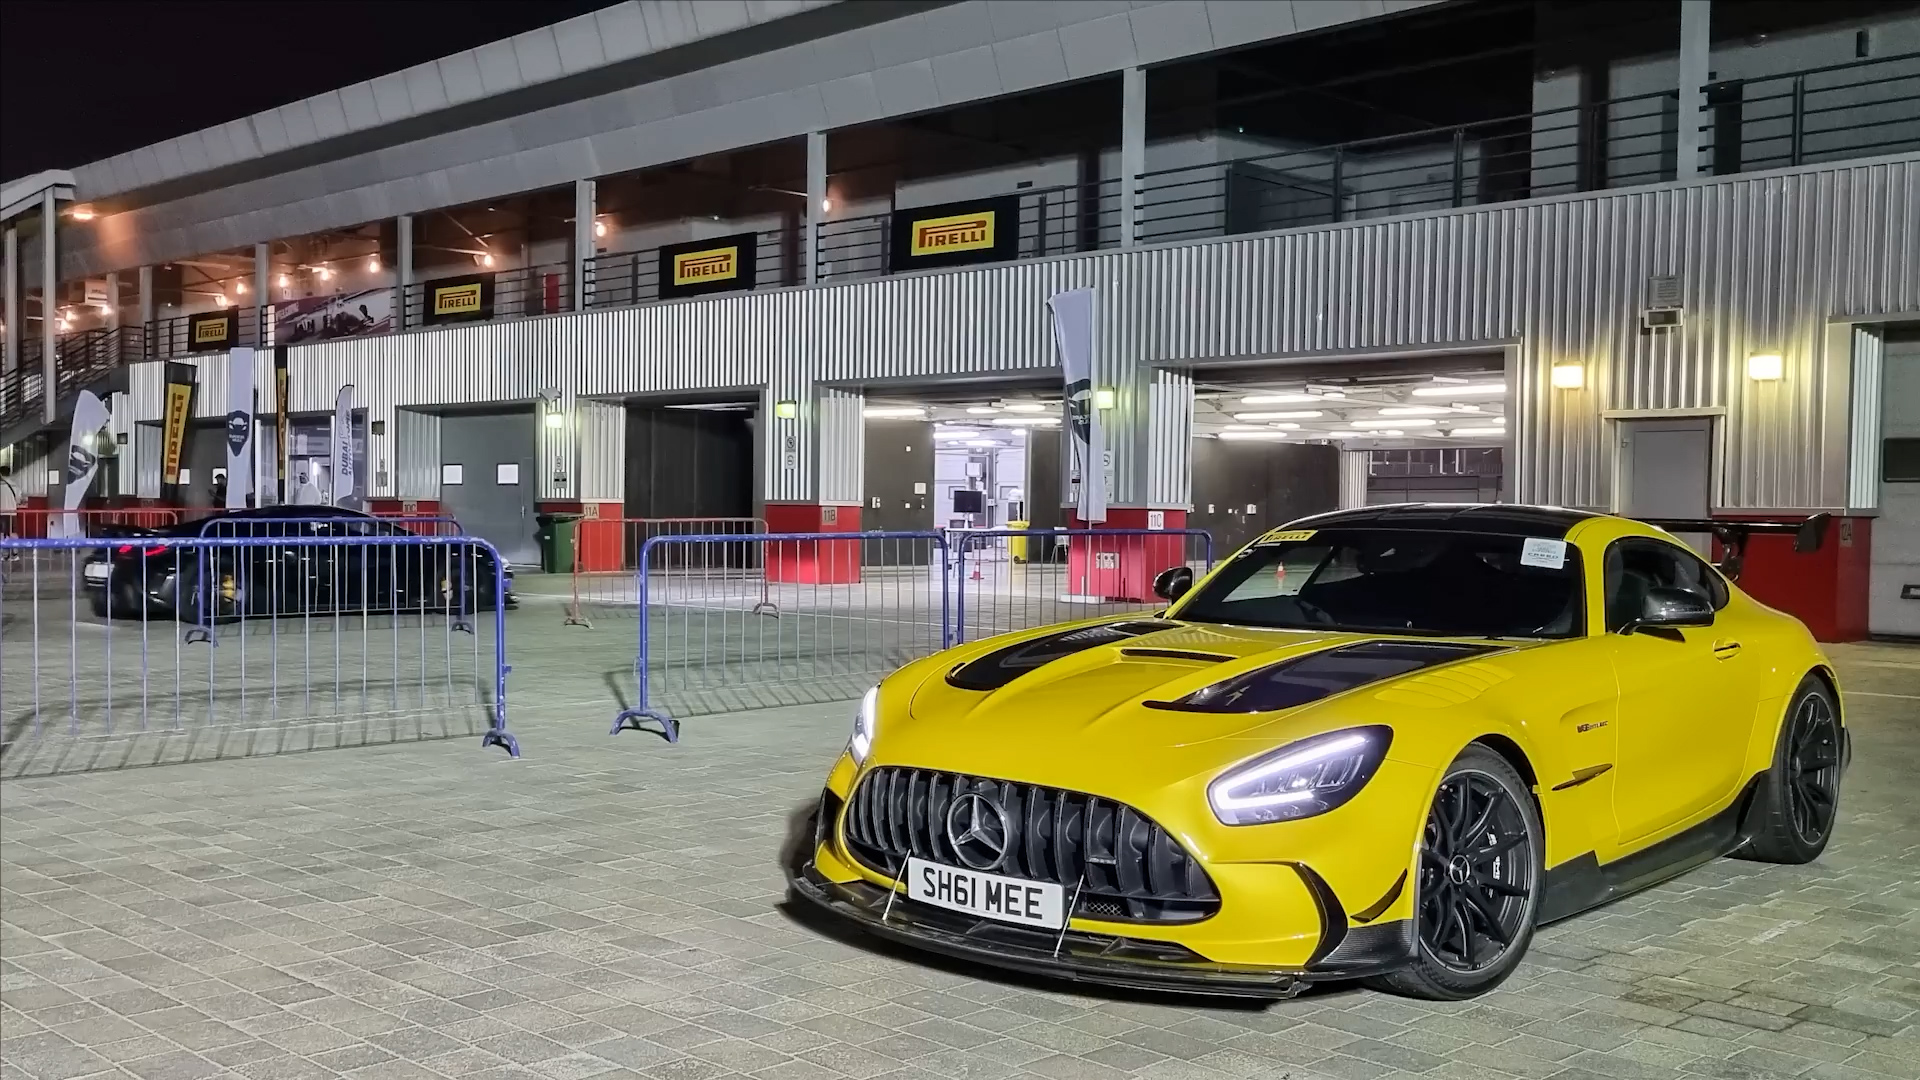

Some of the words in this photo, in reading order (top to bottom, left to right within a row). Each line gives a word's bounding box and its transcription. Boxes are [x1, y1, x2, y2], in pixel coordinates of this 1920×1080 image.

[919, 220, 986, 248] PIRELLI
[680, 254, 731, 278] PIRELLI
[439, 290, 476, 308] PIRELLI
[198, 323, 225, 338] PIRELLI
[167, 392, 184, 475] PIRELLI
[341, 441, 349, 476] DUBAI
[824, 510, 835, 521] 11B
[1150, 513, 1162, 528] 11C
[985, 880, 1043, 920] MEE
